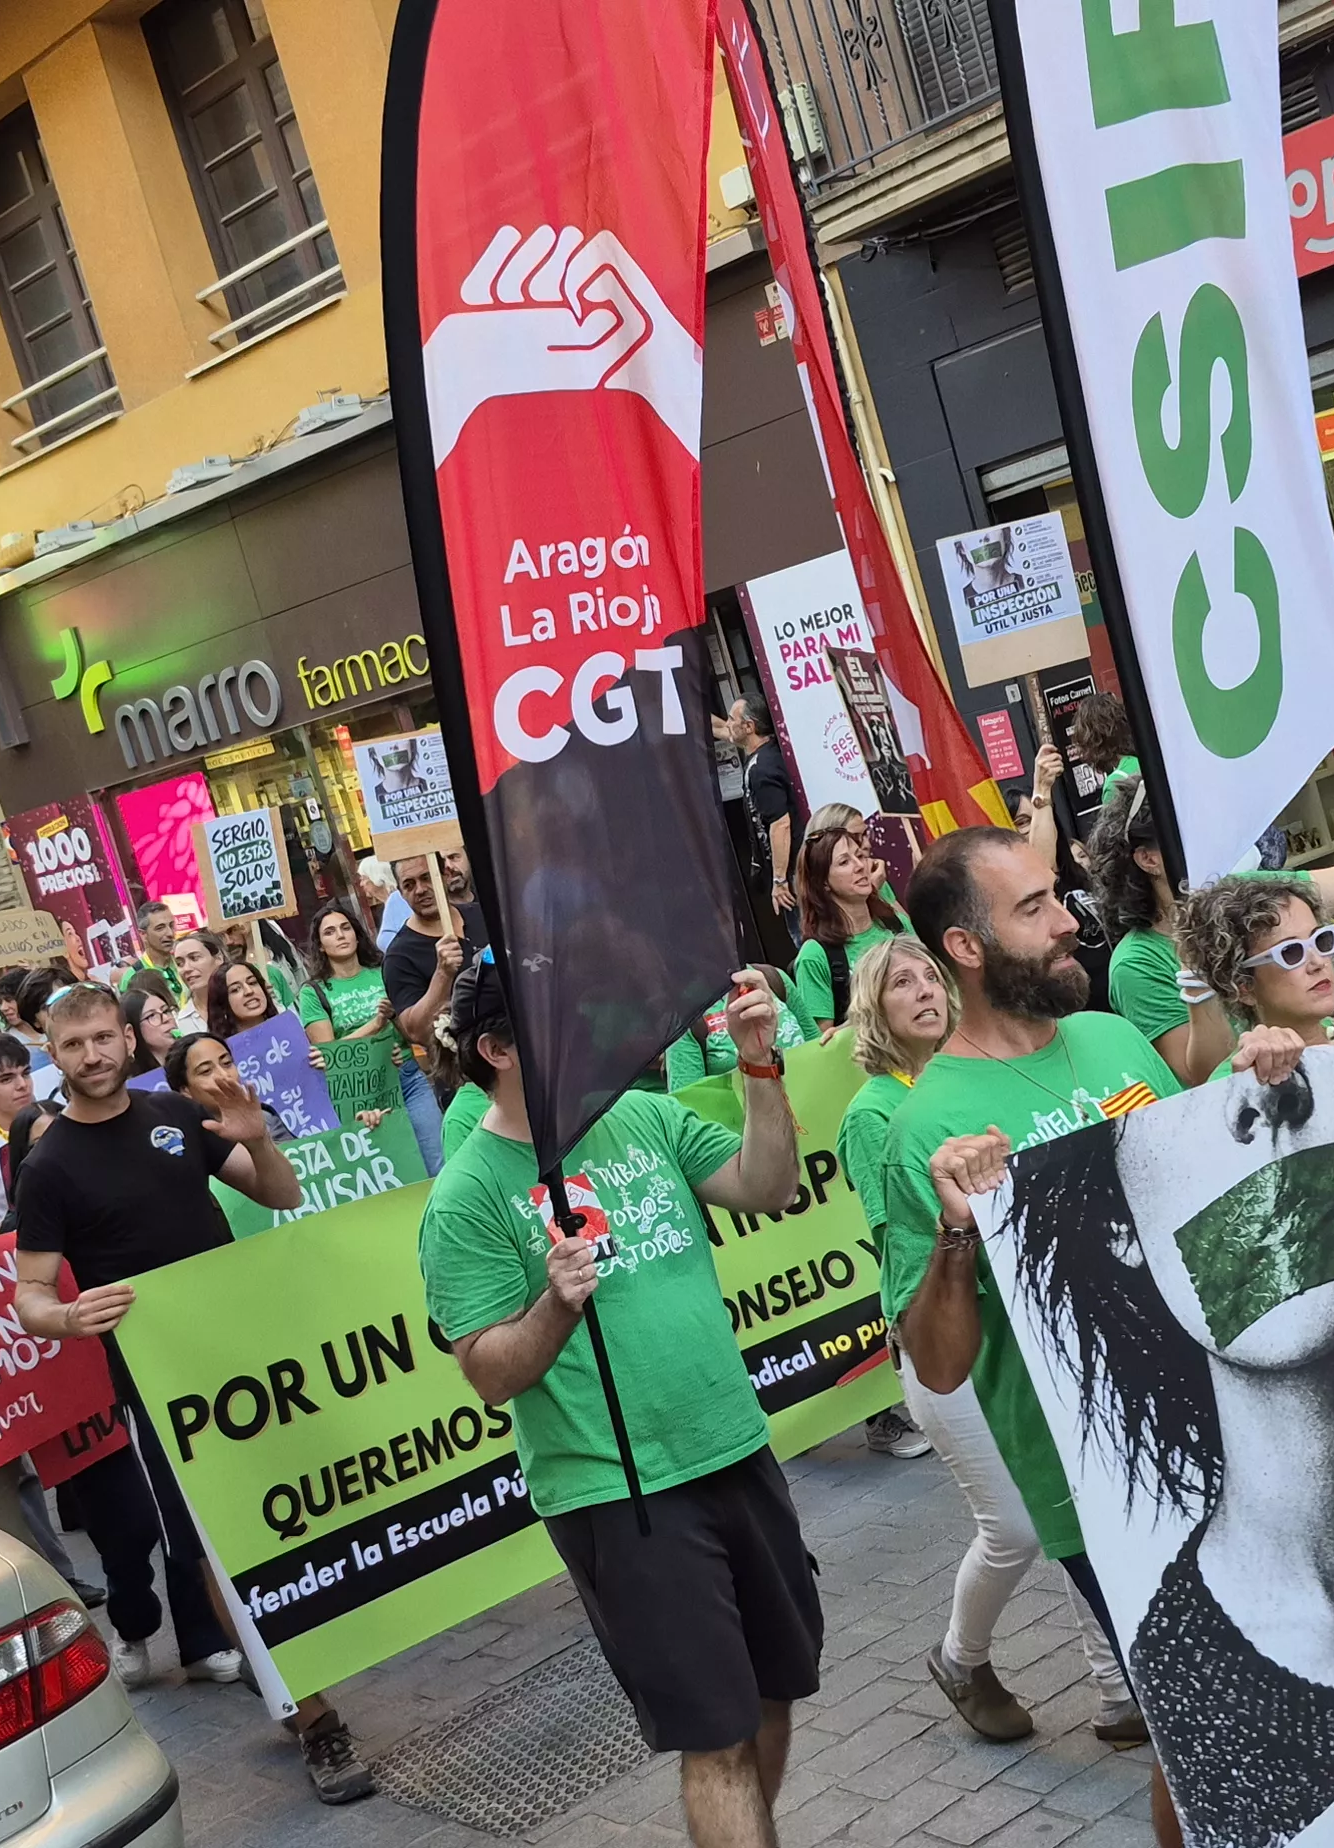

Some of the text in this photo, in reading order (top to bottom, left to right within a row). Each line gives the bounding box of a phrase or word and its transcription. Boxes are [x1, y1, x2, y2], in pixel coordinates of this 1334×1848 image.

[503, 523, 650, 584] Aragón
[974, 584, 1017, 606] POR UNA
[975, 585, 1058, 624] INSPECCIÓN
[501, 604, 556, 647] La
[774, 603, 856, 642] LO MEJOR
[1011, 616, 1019, 625] Y
[1020, 604, 1054, 623] JUSTA
[779, 622, 863, 664] PARA MI
[787, 657, 833, 692] SAL
[494, 645, 687, 763] CGT
[1049, 684, 1093, 707] Fotos Carnet
[114, 660, 281, 770] marro
[384, 785, 423, 803] POR UNA
[384, 788, 456, 815] INSPECCIÓN
[415, 810, 422, 822] Y
[423, 805, 452, 821] JUSTA
[25, 827, 92, 874] 1000
[212, 817, 270, 854] SERGIO,
[218, 853, 238, 871] NO
[237, 839, 271, 865] ESTÁS
[37, 865, 94, 897] PRECIOS
[224, 862, 265, 892] SOLO
[266, 1035, 292, 1065] de
[282, 1100, 312, 1131] DE
[340, 1128, 381, 1162] DE
[167, 1357, 323, 1463] POR
[322, 1314, 417, 1400] UN
[353, 1540, 385, 1576] la
[388, 1493, 493, 1554] Escuela
[820, 1329, 853, 1360] no
[261, 1403, 513, 1543] QUEREMOS
